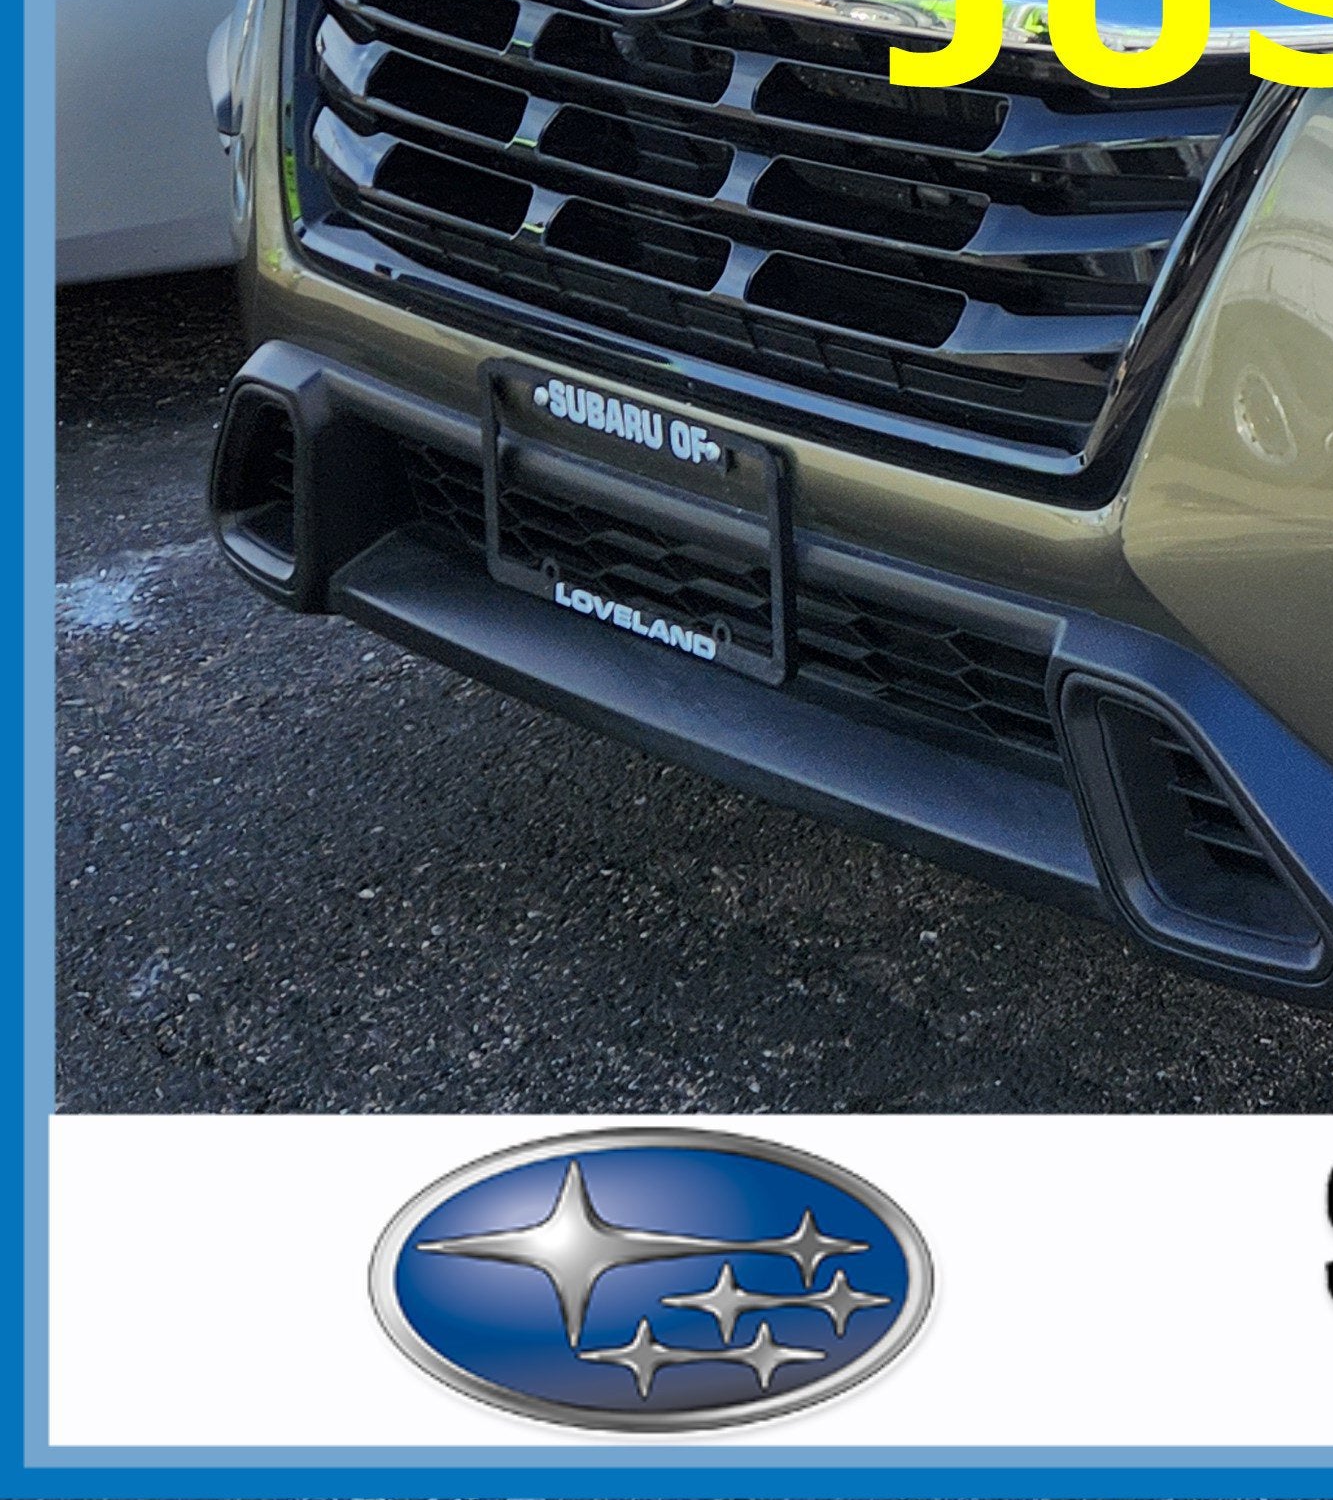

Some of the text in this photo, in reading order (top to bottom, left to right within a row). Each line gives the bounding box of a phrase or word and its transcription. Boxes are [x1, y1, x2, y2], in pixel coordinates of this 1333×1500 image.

[548, 379, 708, 464] SUBARU OF
[555, 582, 717, 660] LOVELAND
